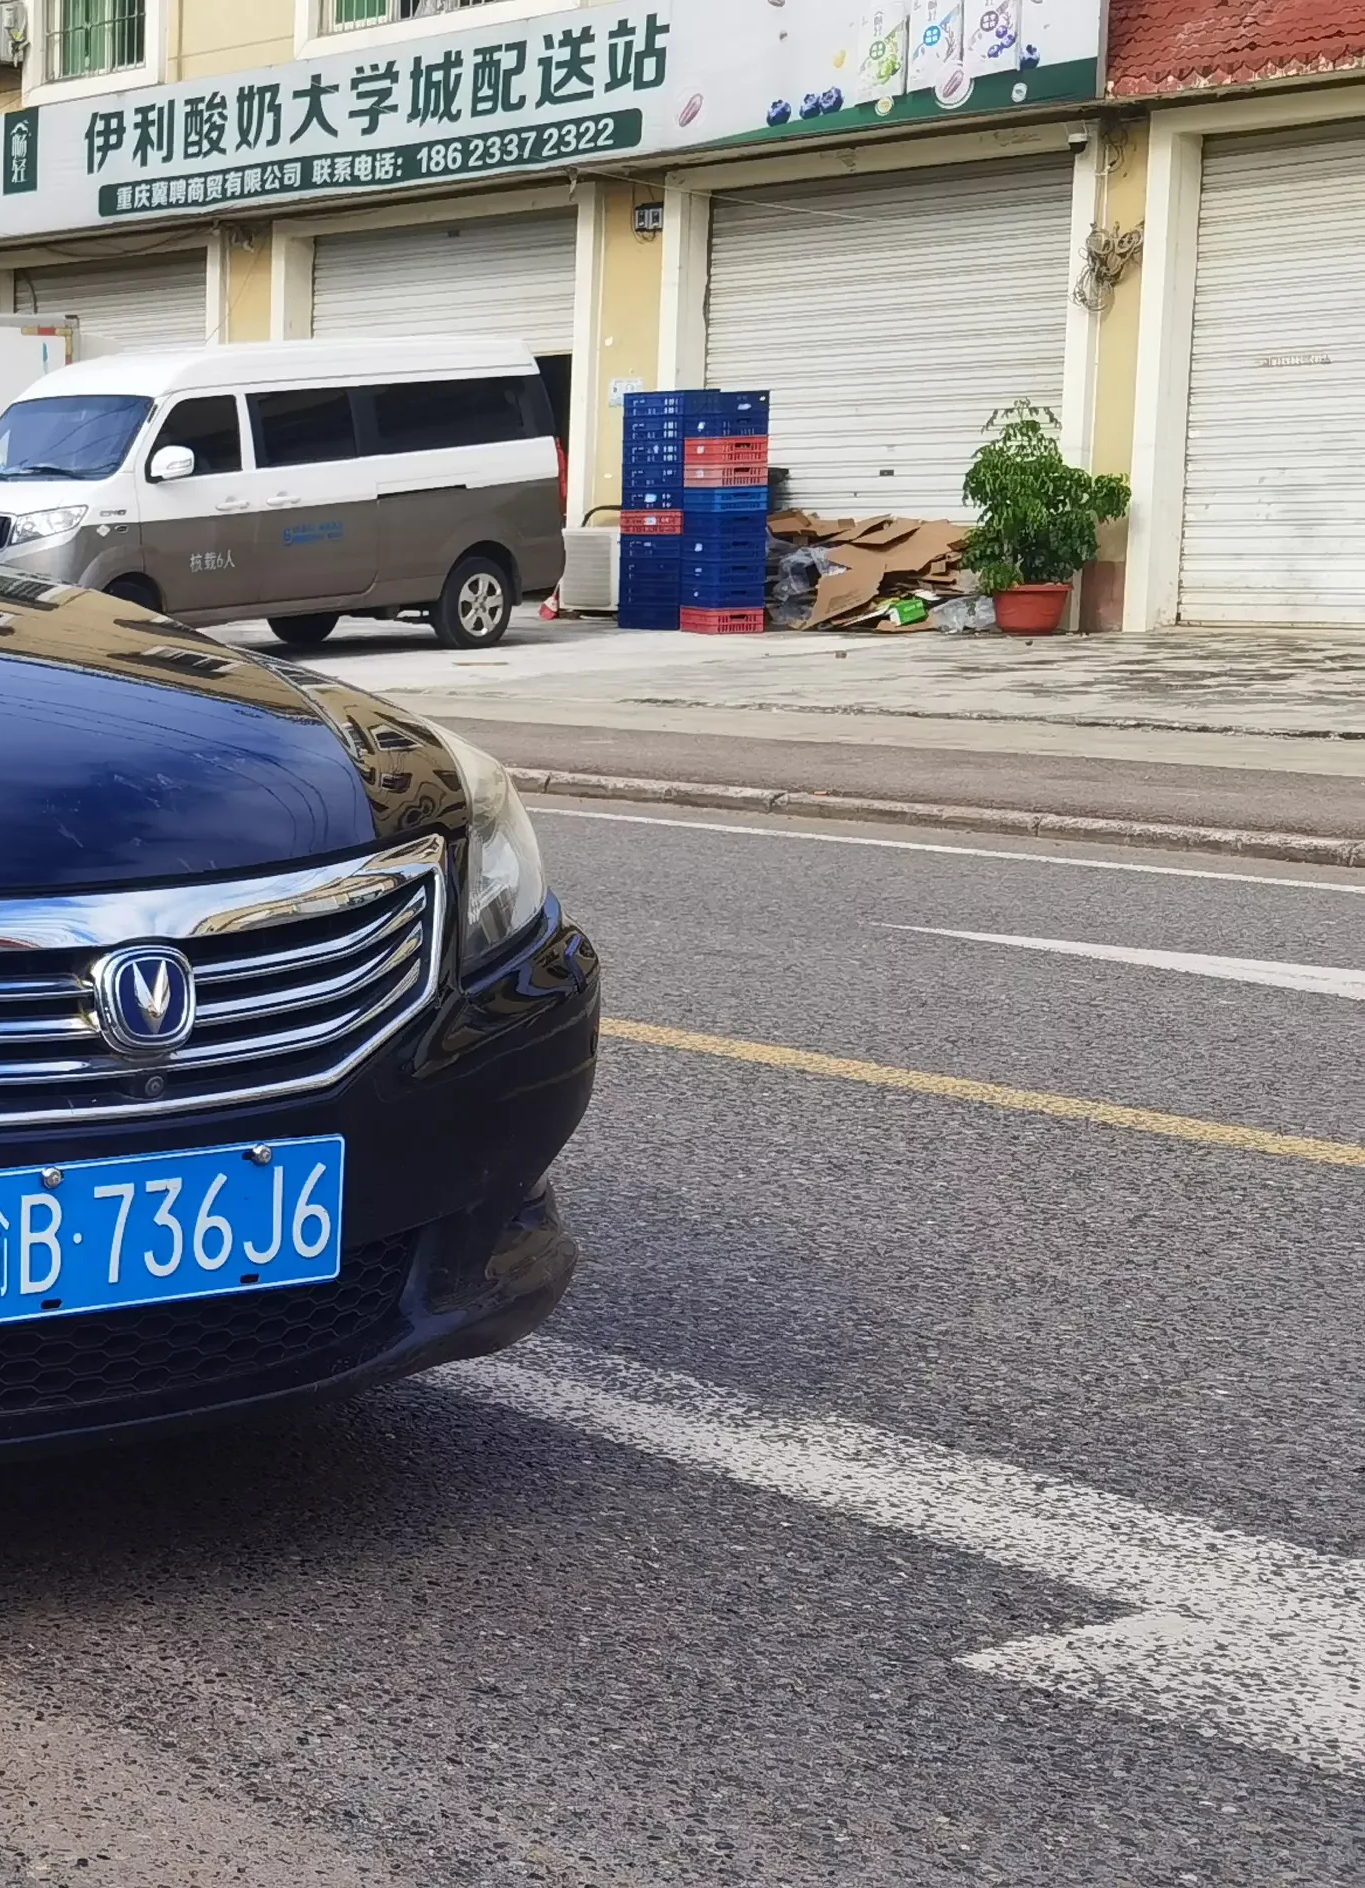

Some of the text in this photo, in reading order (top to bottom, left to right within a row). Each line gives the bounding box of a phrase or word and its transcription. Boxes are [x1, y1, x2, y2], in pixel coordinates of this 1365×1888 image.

[85, 13, 671, 175] 伊利酸奶大学城配送站
[189, 549, 236, 573] 核载6人
